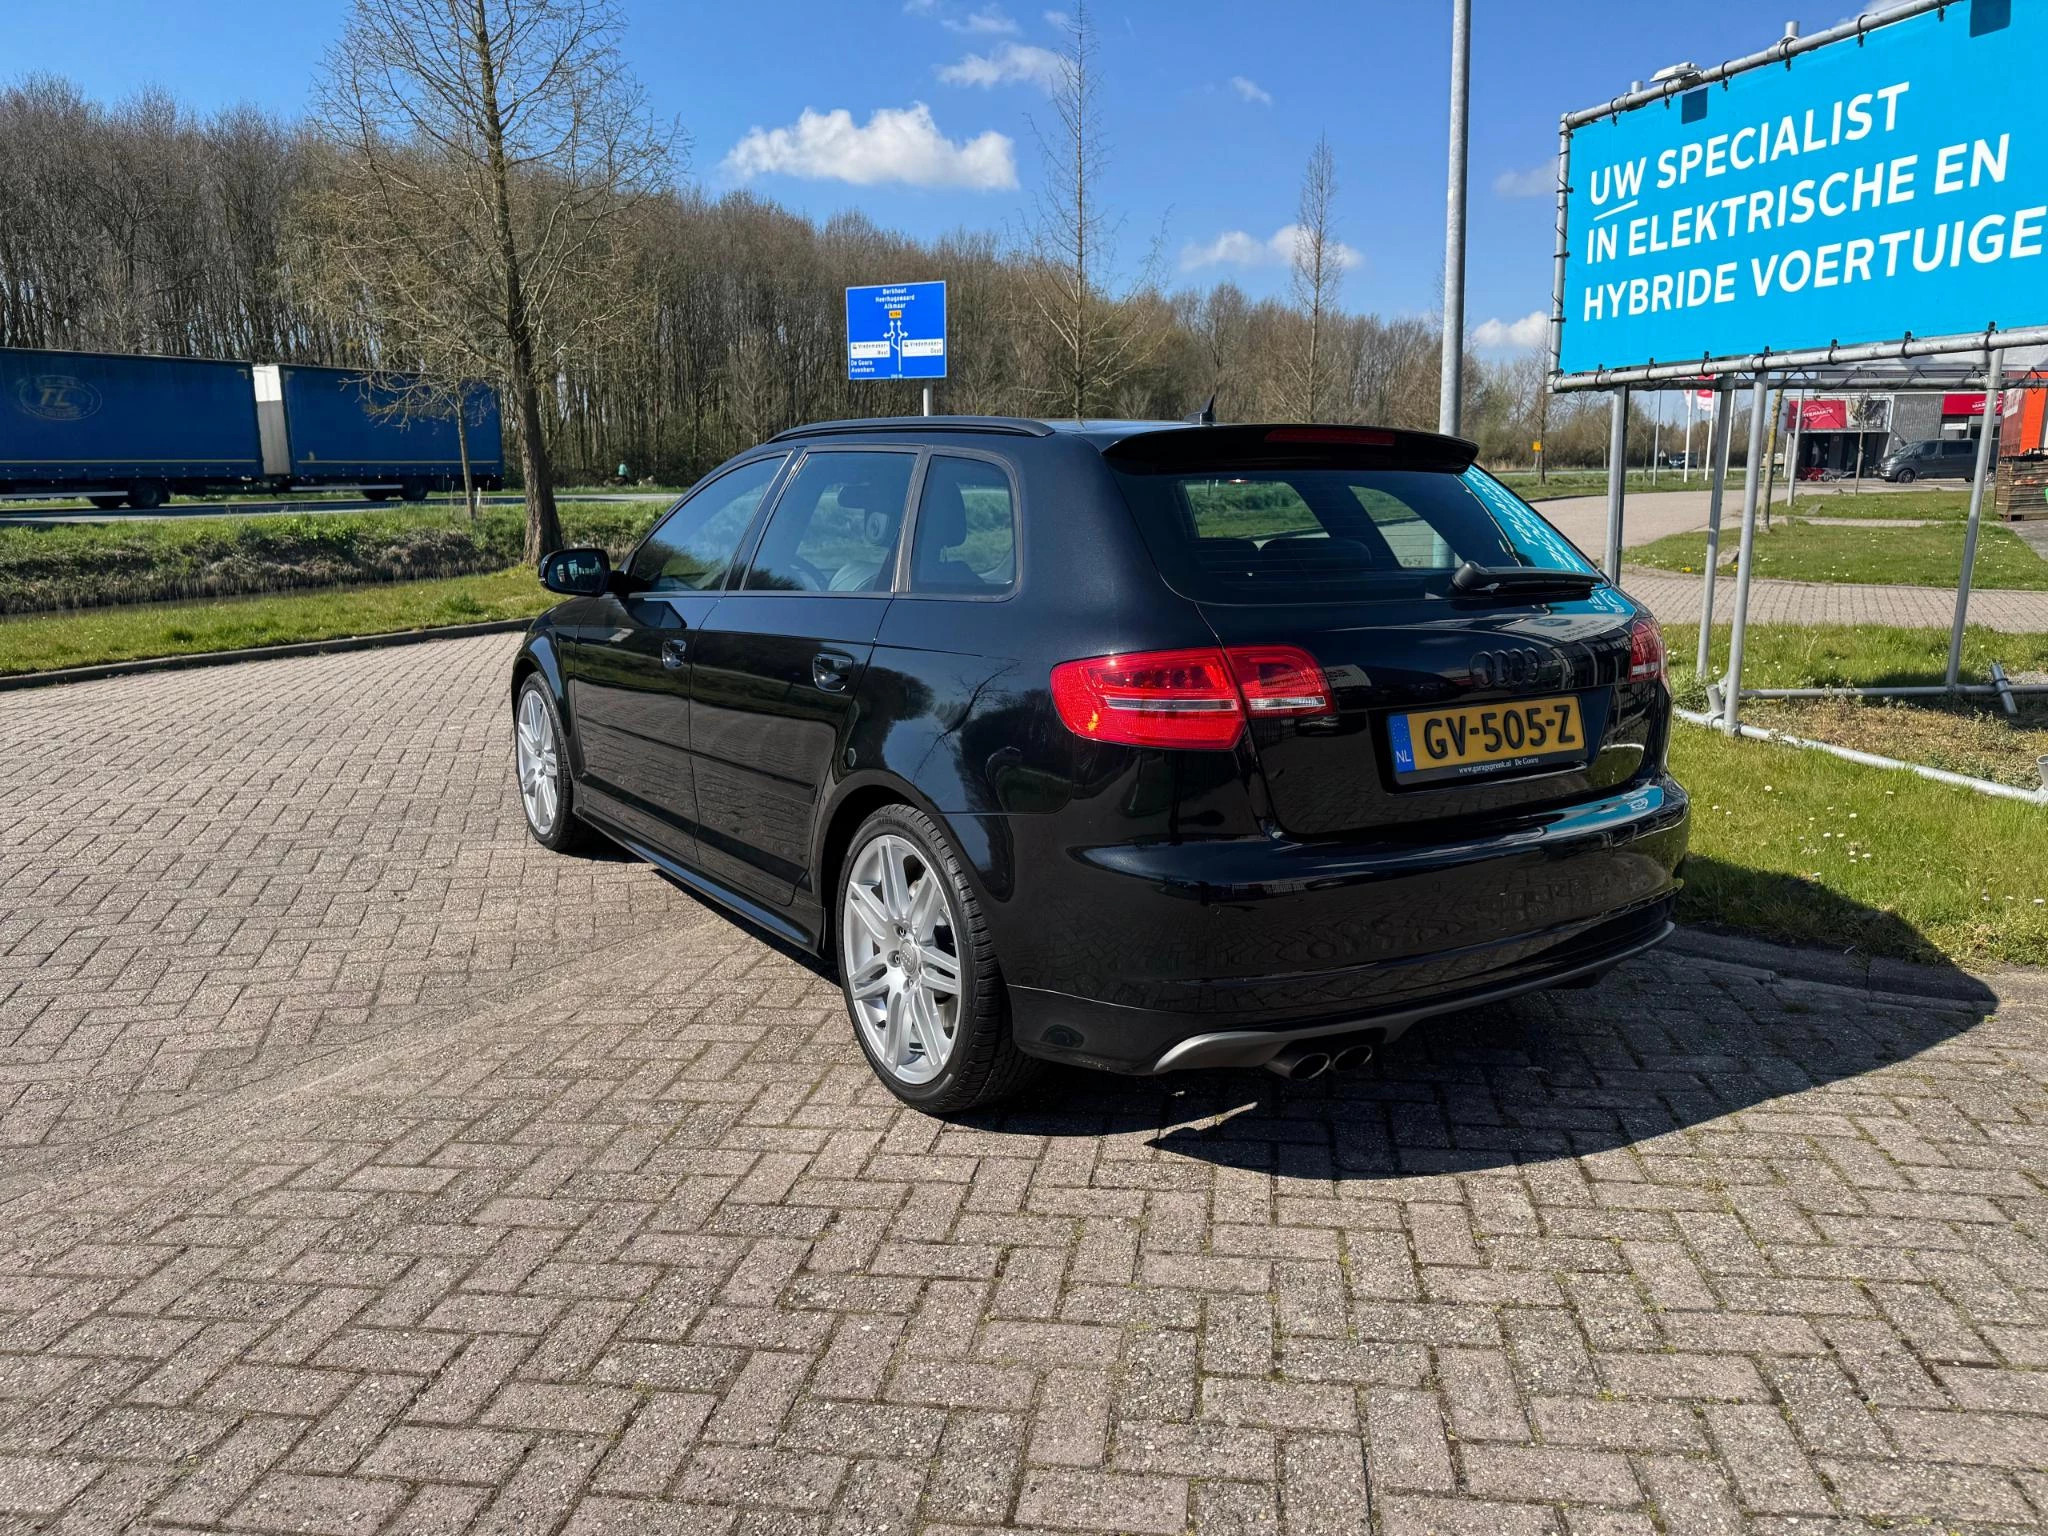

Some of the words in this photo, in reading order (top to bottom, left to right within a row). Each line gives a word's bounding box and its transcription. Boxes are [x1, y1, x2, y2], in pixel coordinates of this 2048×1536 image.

[1586, 224, 1618, 265] IN
[1627, 154, 1918, 258] ELEKTRISCHE
[1934, 133, 2011, 196] EN
[1590, 156, 1647, 207] UW
[1656, 81, 1910, 189] SPECIALIST
[1582, 261, 1738, 323] HYBRIDE
[1751, 205, 2048, 298] VOERTUIGE
[1396, 750, 1412, 763] NL
[1423, 704, 1576, 760] GV-505-Z
